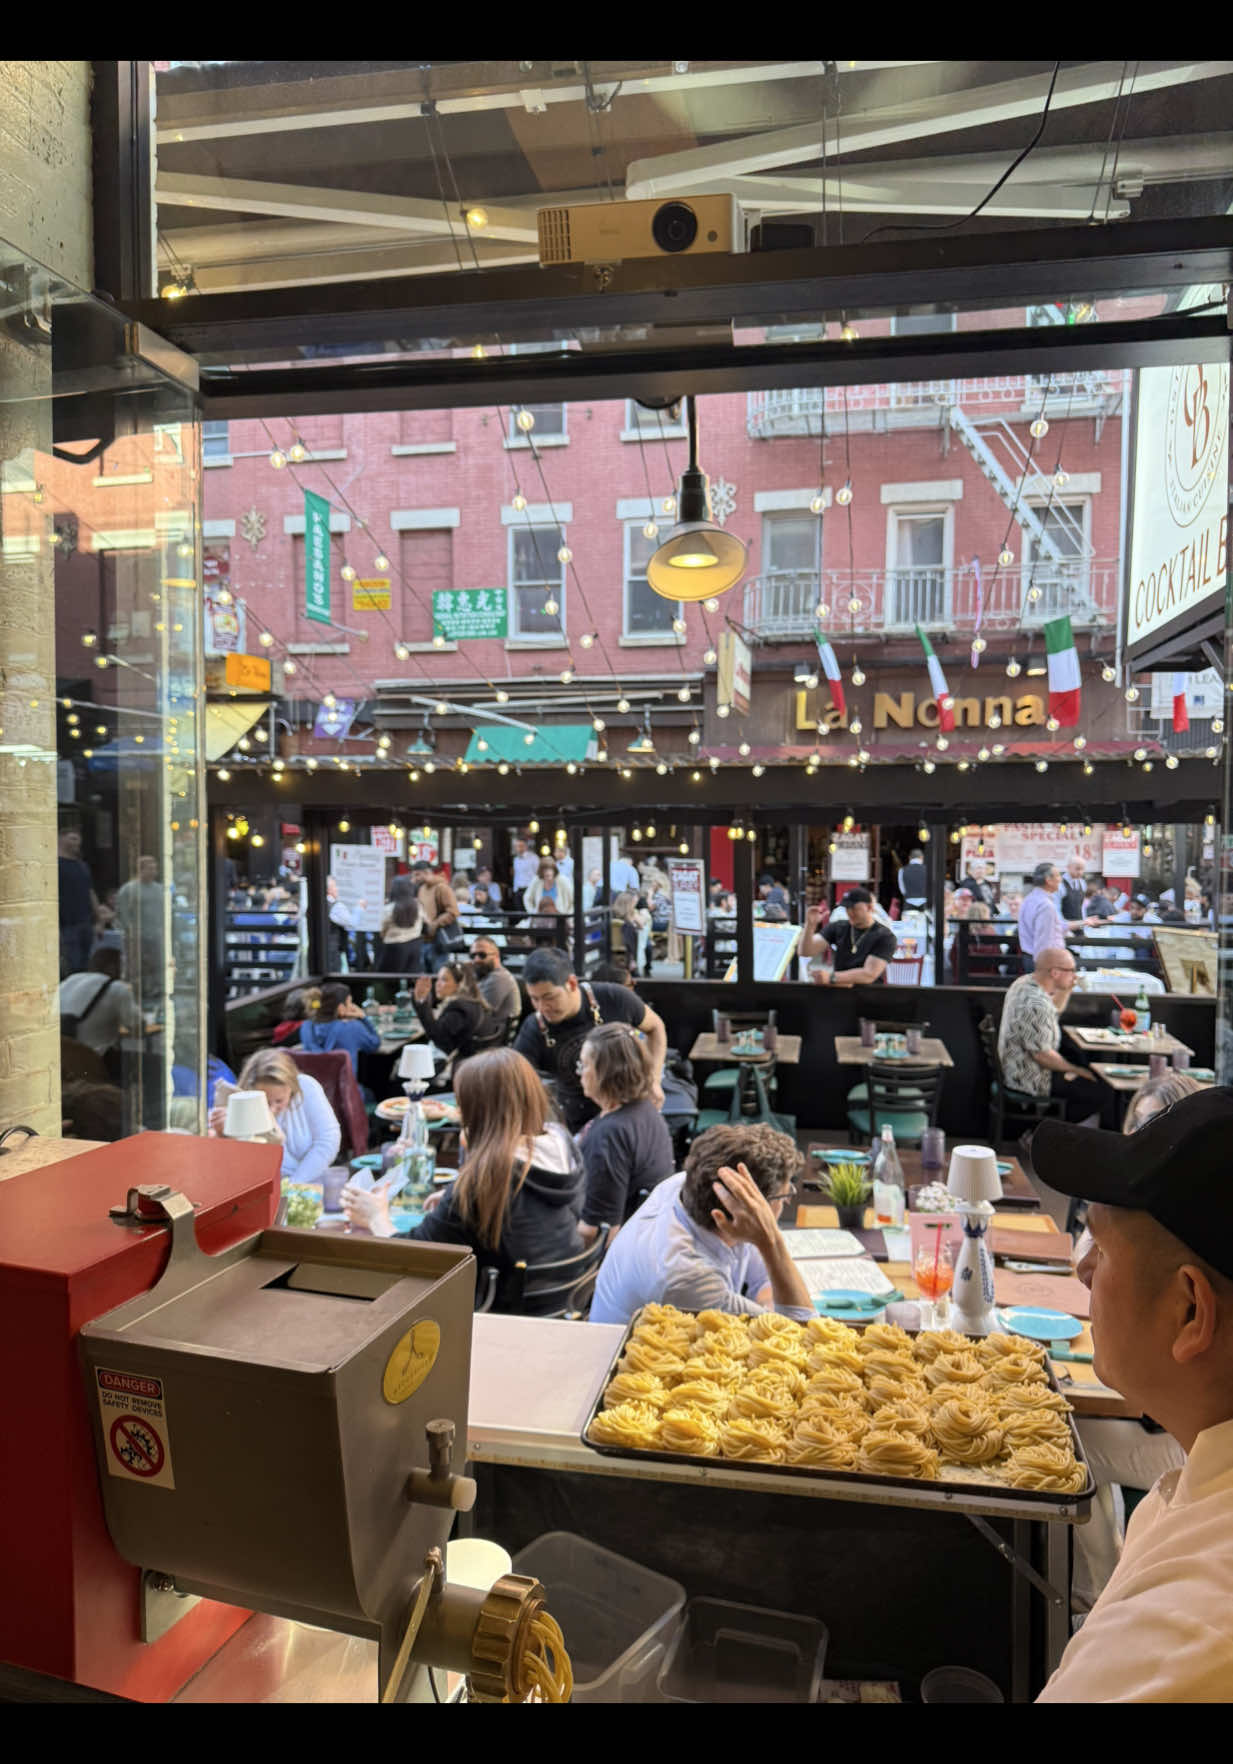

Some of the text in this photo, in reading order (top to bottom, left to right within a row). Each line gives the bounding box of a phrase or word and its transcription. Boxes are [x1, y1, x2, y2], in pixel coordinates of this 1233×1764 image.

[1136, 527, 1211, 628] COCKTAIL
[796, 691, 1045, 730] La Nonna
[103, 1374, 157, 1394] DANGER
[102, 1391, 161, 1409] DO NOT REMOVE
[103, 1399, 162, 1417] SAFETY DEVICES
